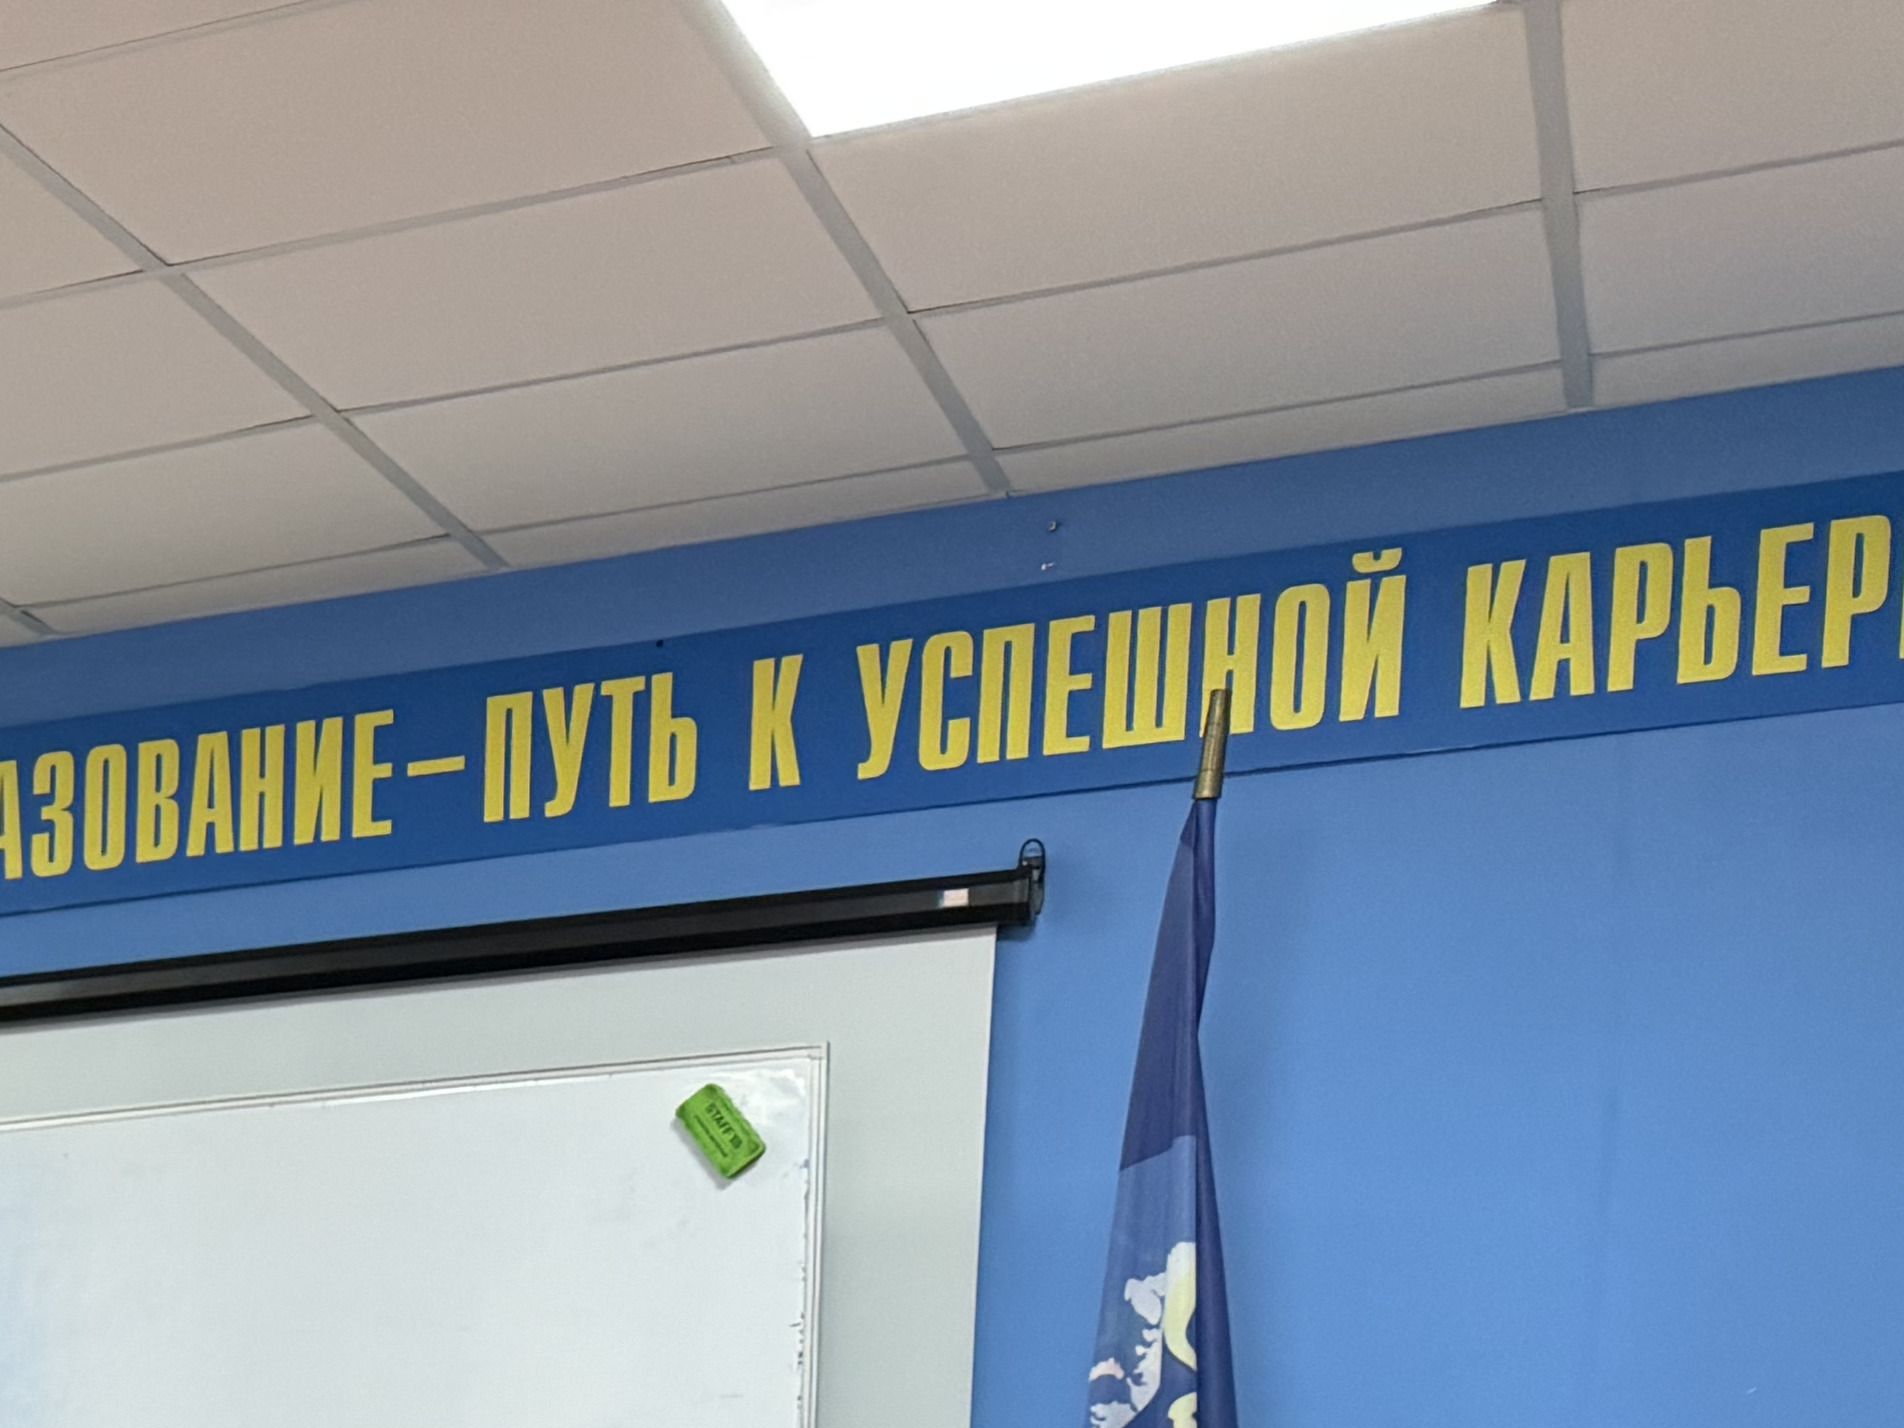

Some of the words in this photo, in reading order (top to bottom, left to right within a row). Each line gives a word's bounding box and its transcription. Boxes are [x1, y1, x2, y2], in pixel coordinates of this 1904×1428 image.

[749, 655, 803, 790] К
[856, 548, 1407, 780] УСПЕШНОЙ
[1461, 514, 1904, 708] КАРЬЕР
